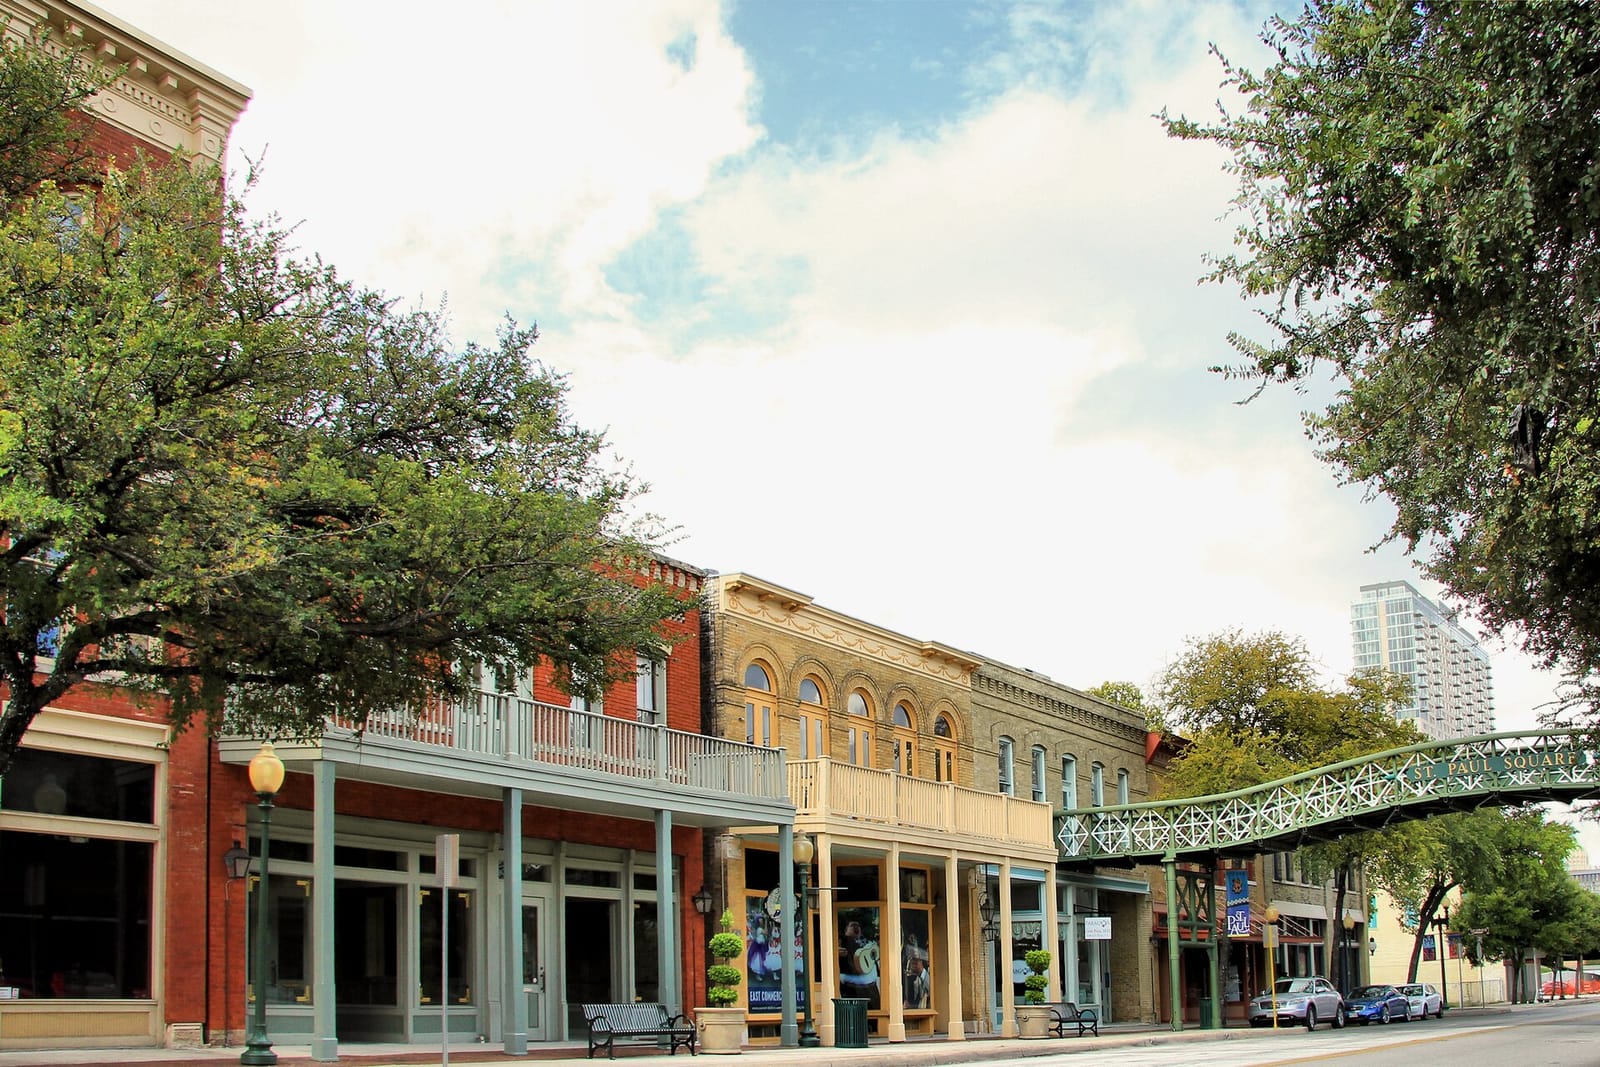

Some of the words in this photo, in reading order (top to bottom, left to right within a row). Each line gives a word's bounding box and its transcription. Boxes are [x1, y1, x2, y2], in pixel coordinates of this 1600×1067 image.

[1448, 759, 1493, 776] PAUL
[1503, 752, 1577, 770] SQUARE
[1227, 915, 1250, 935] PAUL
[749, 991, 761, 1001] EAST
